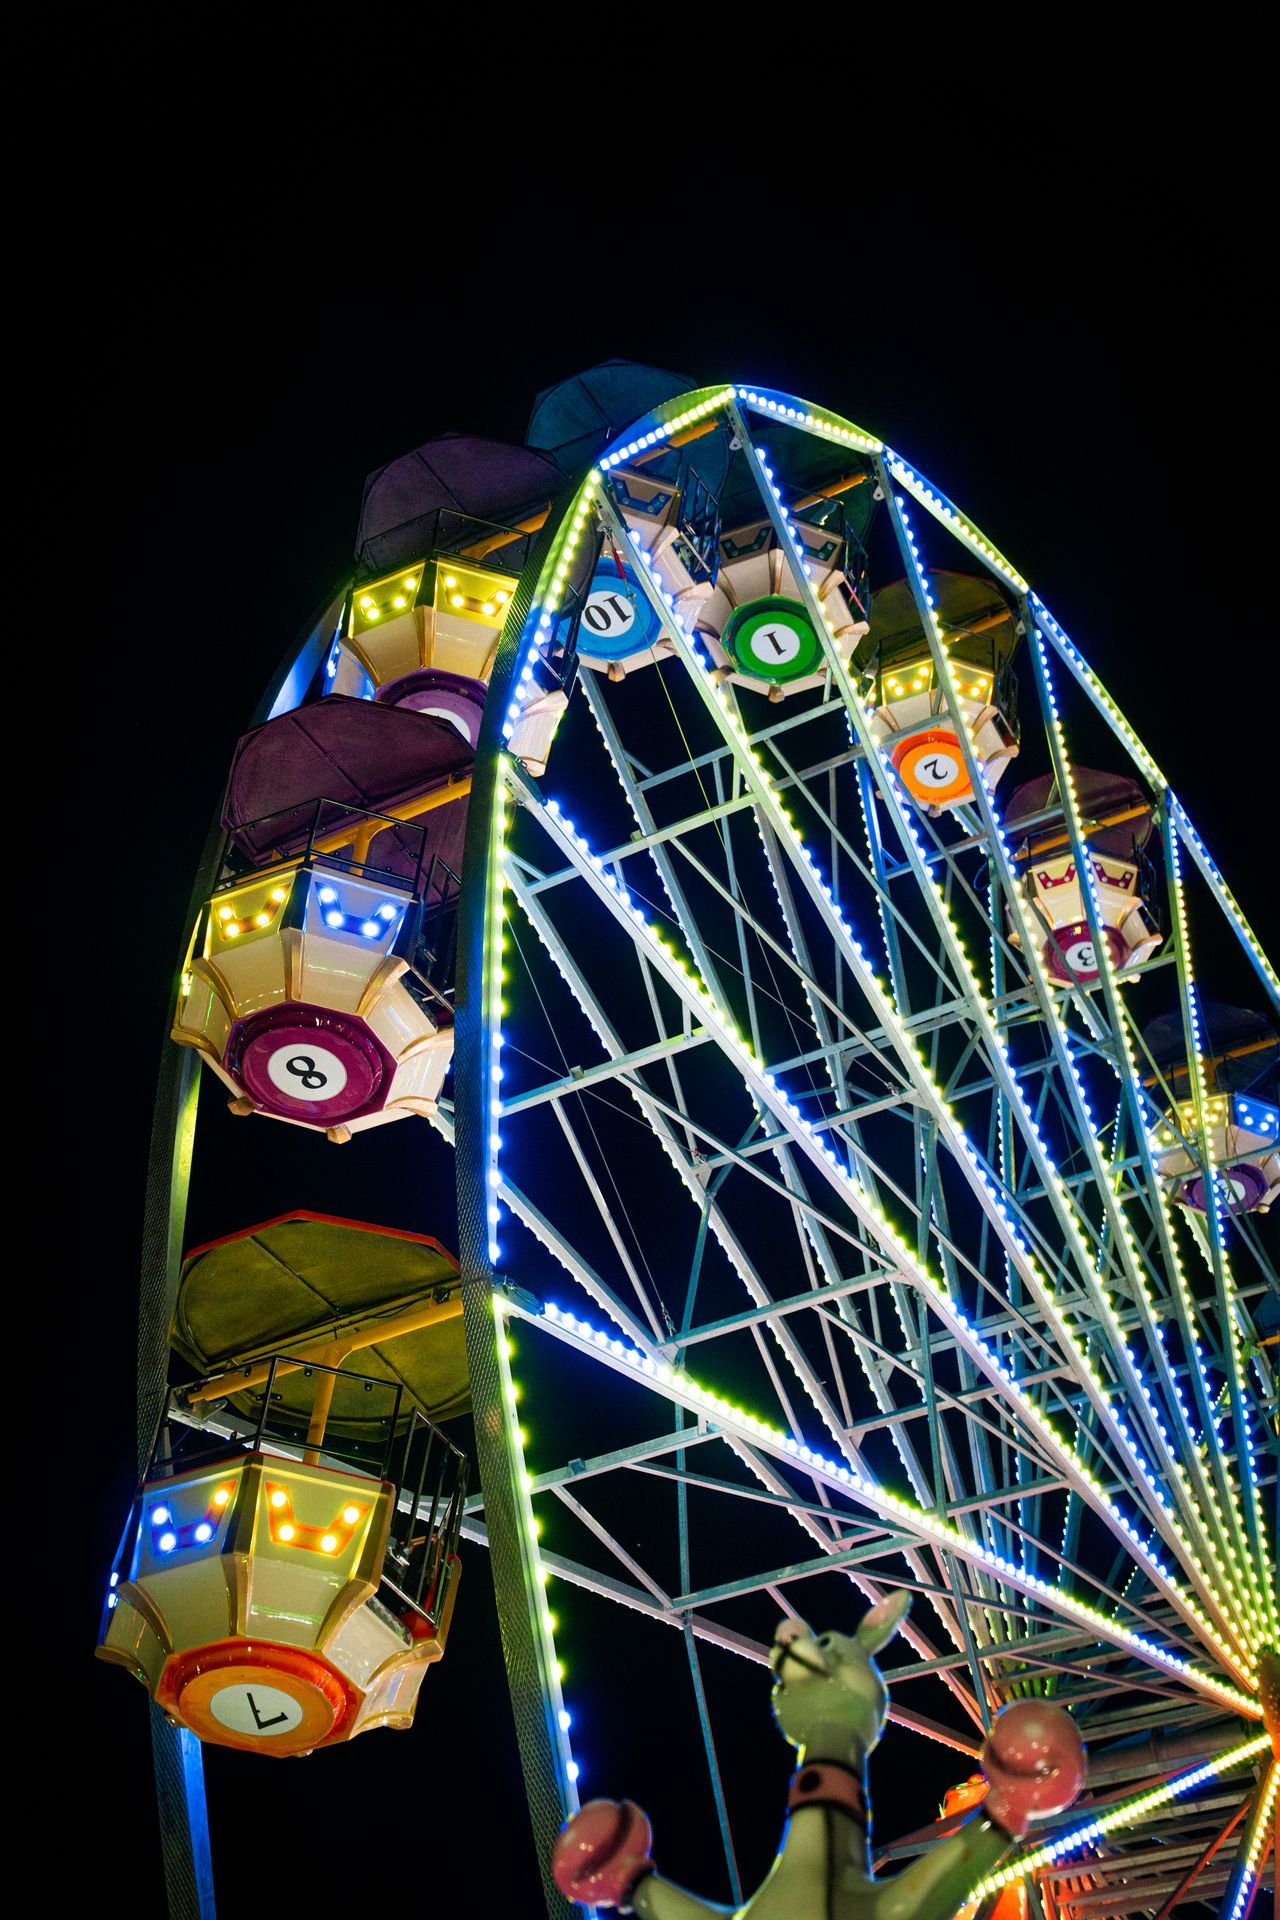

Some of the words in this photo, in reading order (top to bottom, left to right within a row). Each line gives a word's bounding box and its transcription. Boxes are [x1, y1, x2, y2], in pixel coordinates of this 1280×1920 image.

[584, 595, 631, 631] 10
[763, 631, 786, 655] 1
[923, 758, 948, 780] 2
[1077, 947, 1095, 966] 3
[286, 1055, 328, 1089] 8
[247, 1692, 289, 1730] 7
